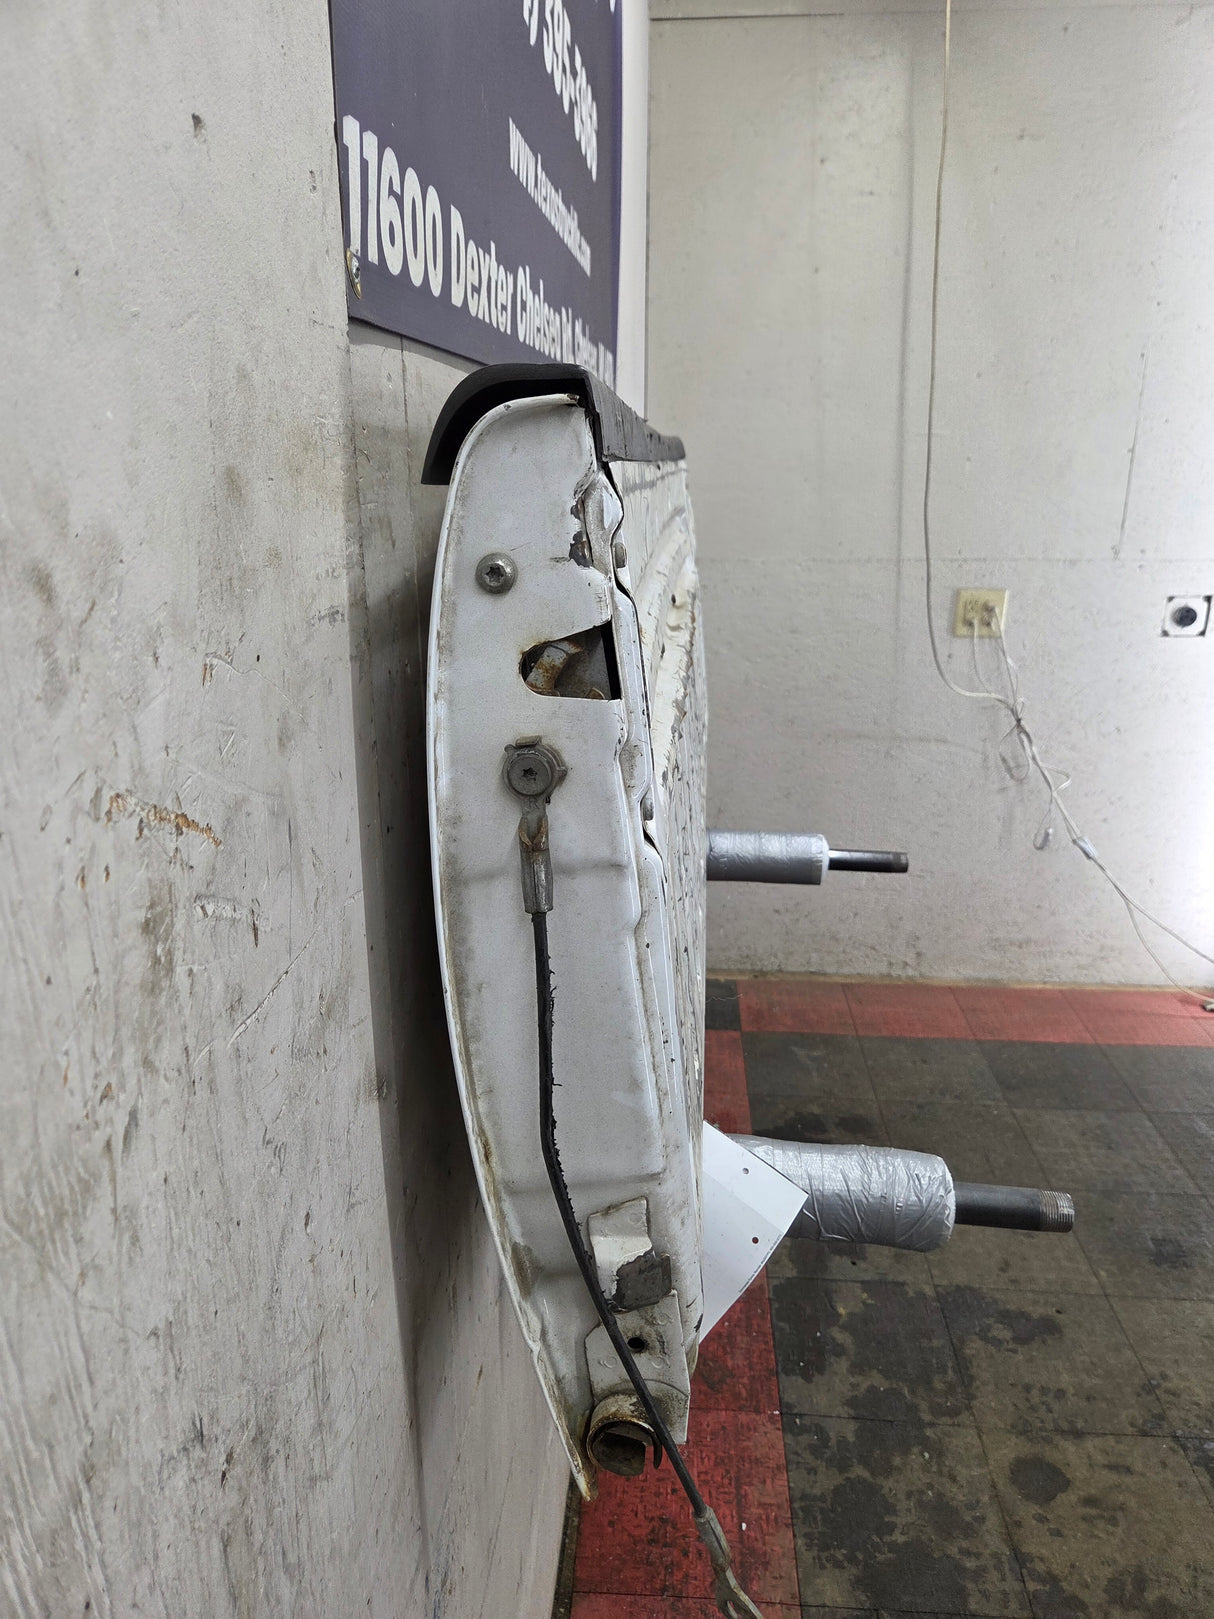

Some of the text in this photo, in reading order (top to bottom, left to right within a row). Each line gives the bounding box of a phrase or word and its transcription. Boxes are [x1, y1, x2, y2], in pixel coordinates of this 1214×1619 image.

[343, 115, 443, 297] 11600
[451, 204, 513, 335] Dexter
[517, 265, 561, 362] Chelsea
